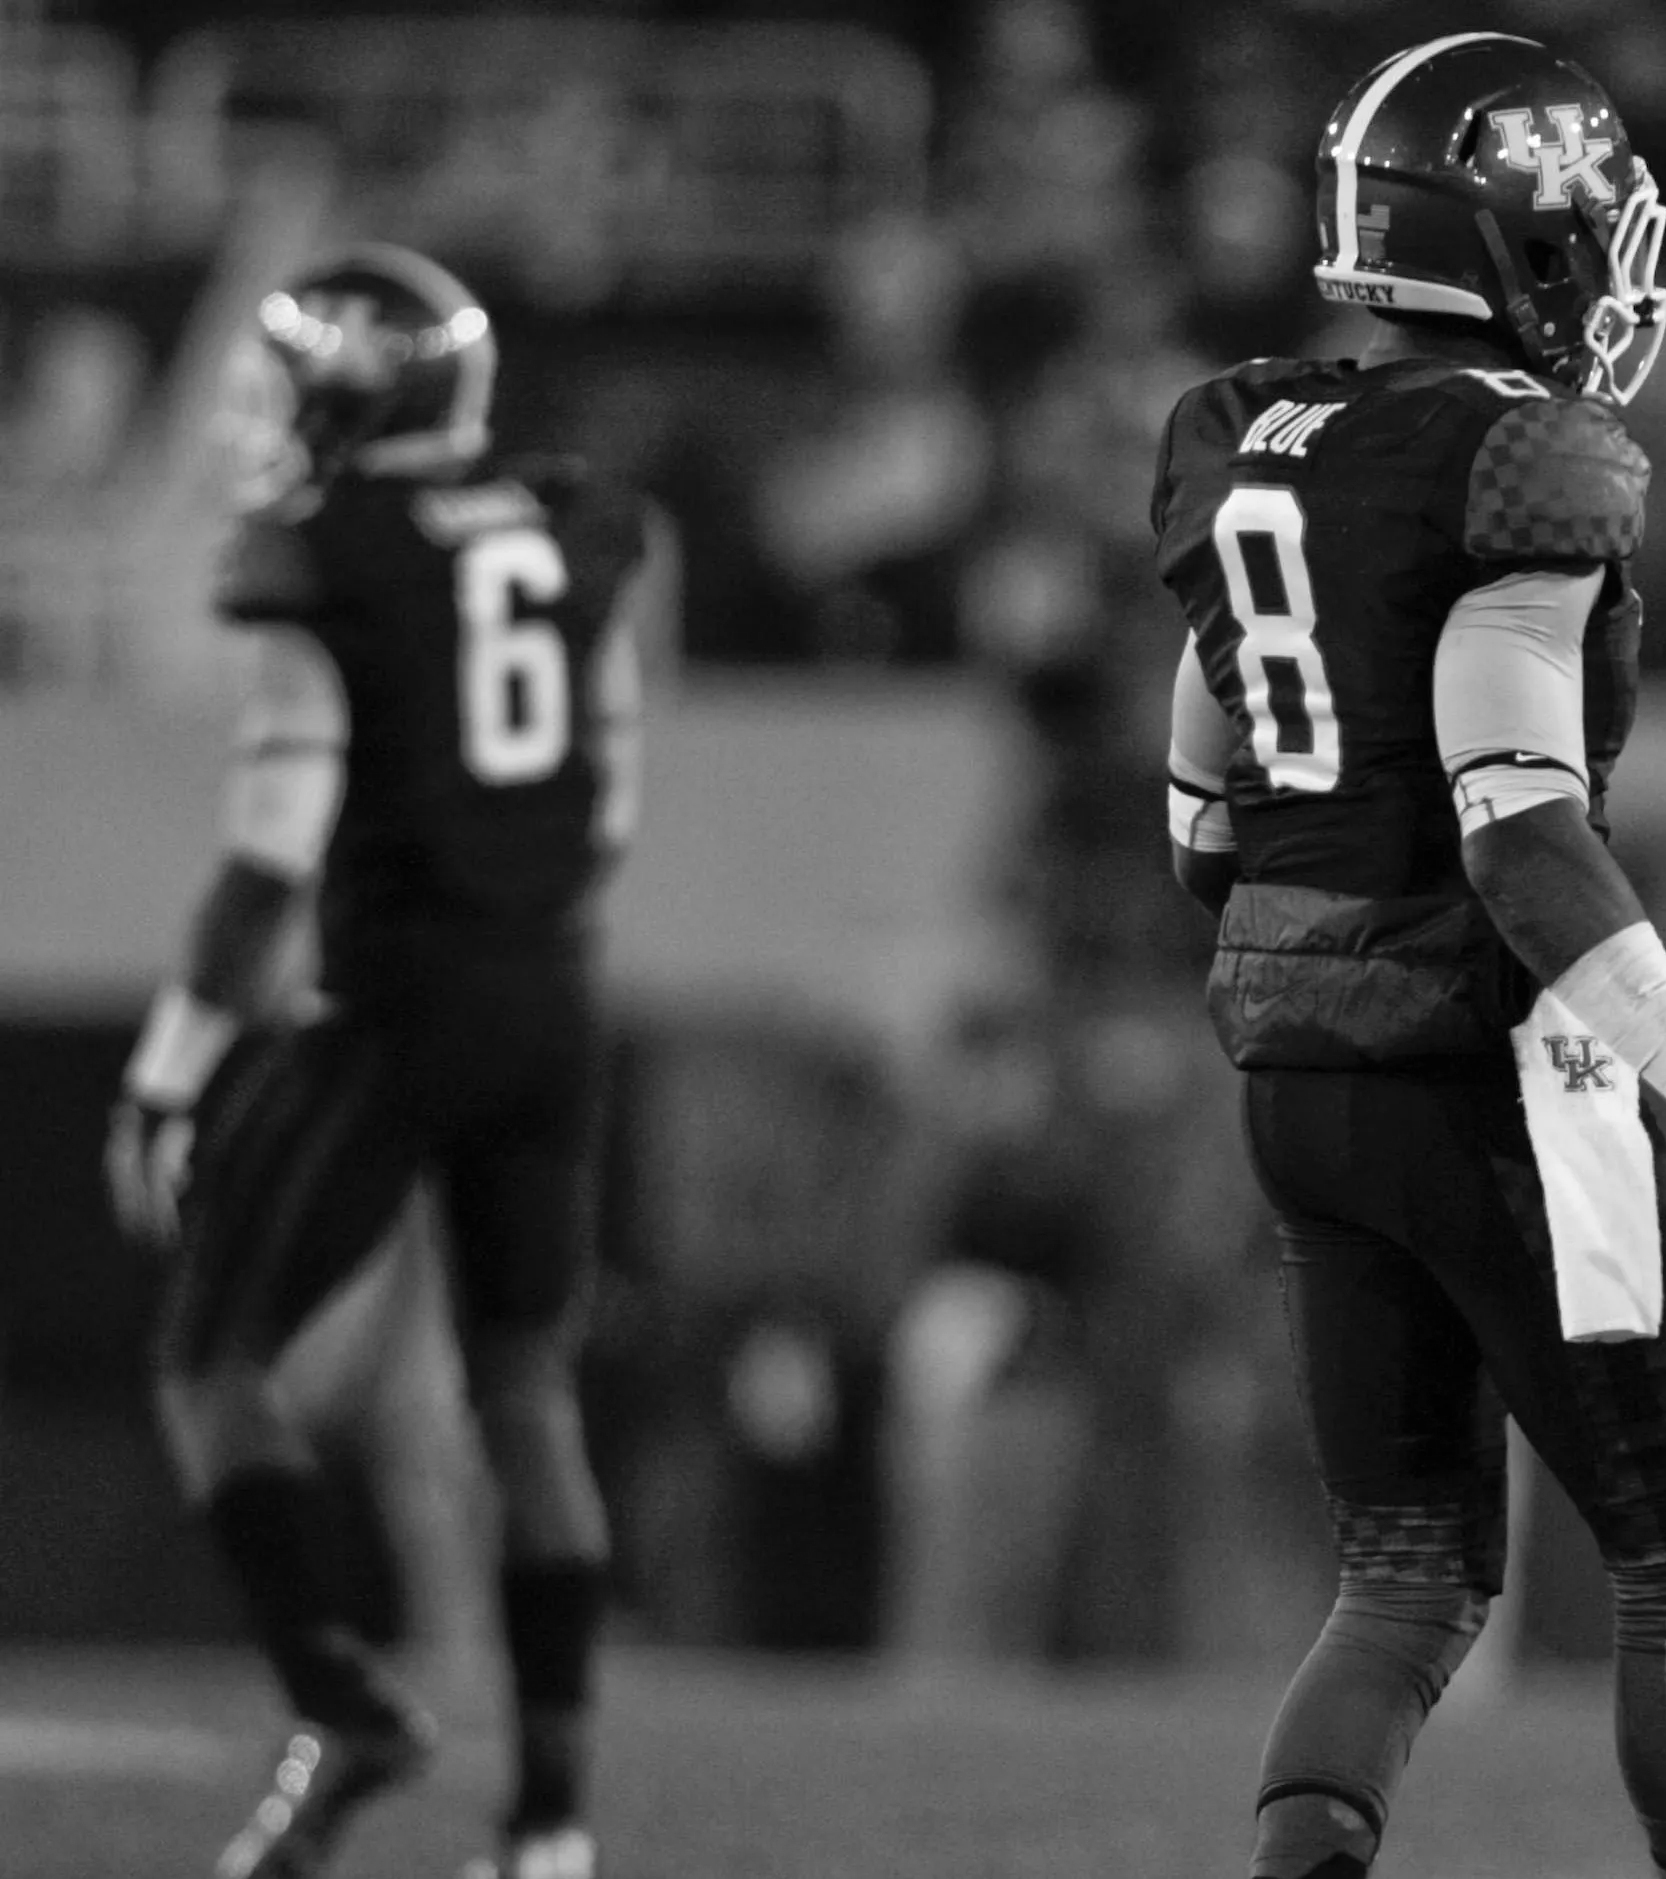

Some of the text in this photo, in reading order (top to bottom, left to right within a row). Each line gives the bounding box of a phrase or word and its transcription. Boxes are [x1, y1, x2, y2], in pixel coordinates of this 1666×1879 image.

[1488, 103, 1616, 210] UK
[1239, 399, 1347, 457] BLUE
[457, 529, 569, 785] 6
[1214, 485, 1341, 792] 8
[1541, 1034, 1615, 1093] UK
